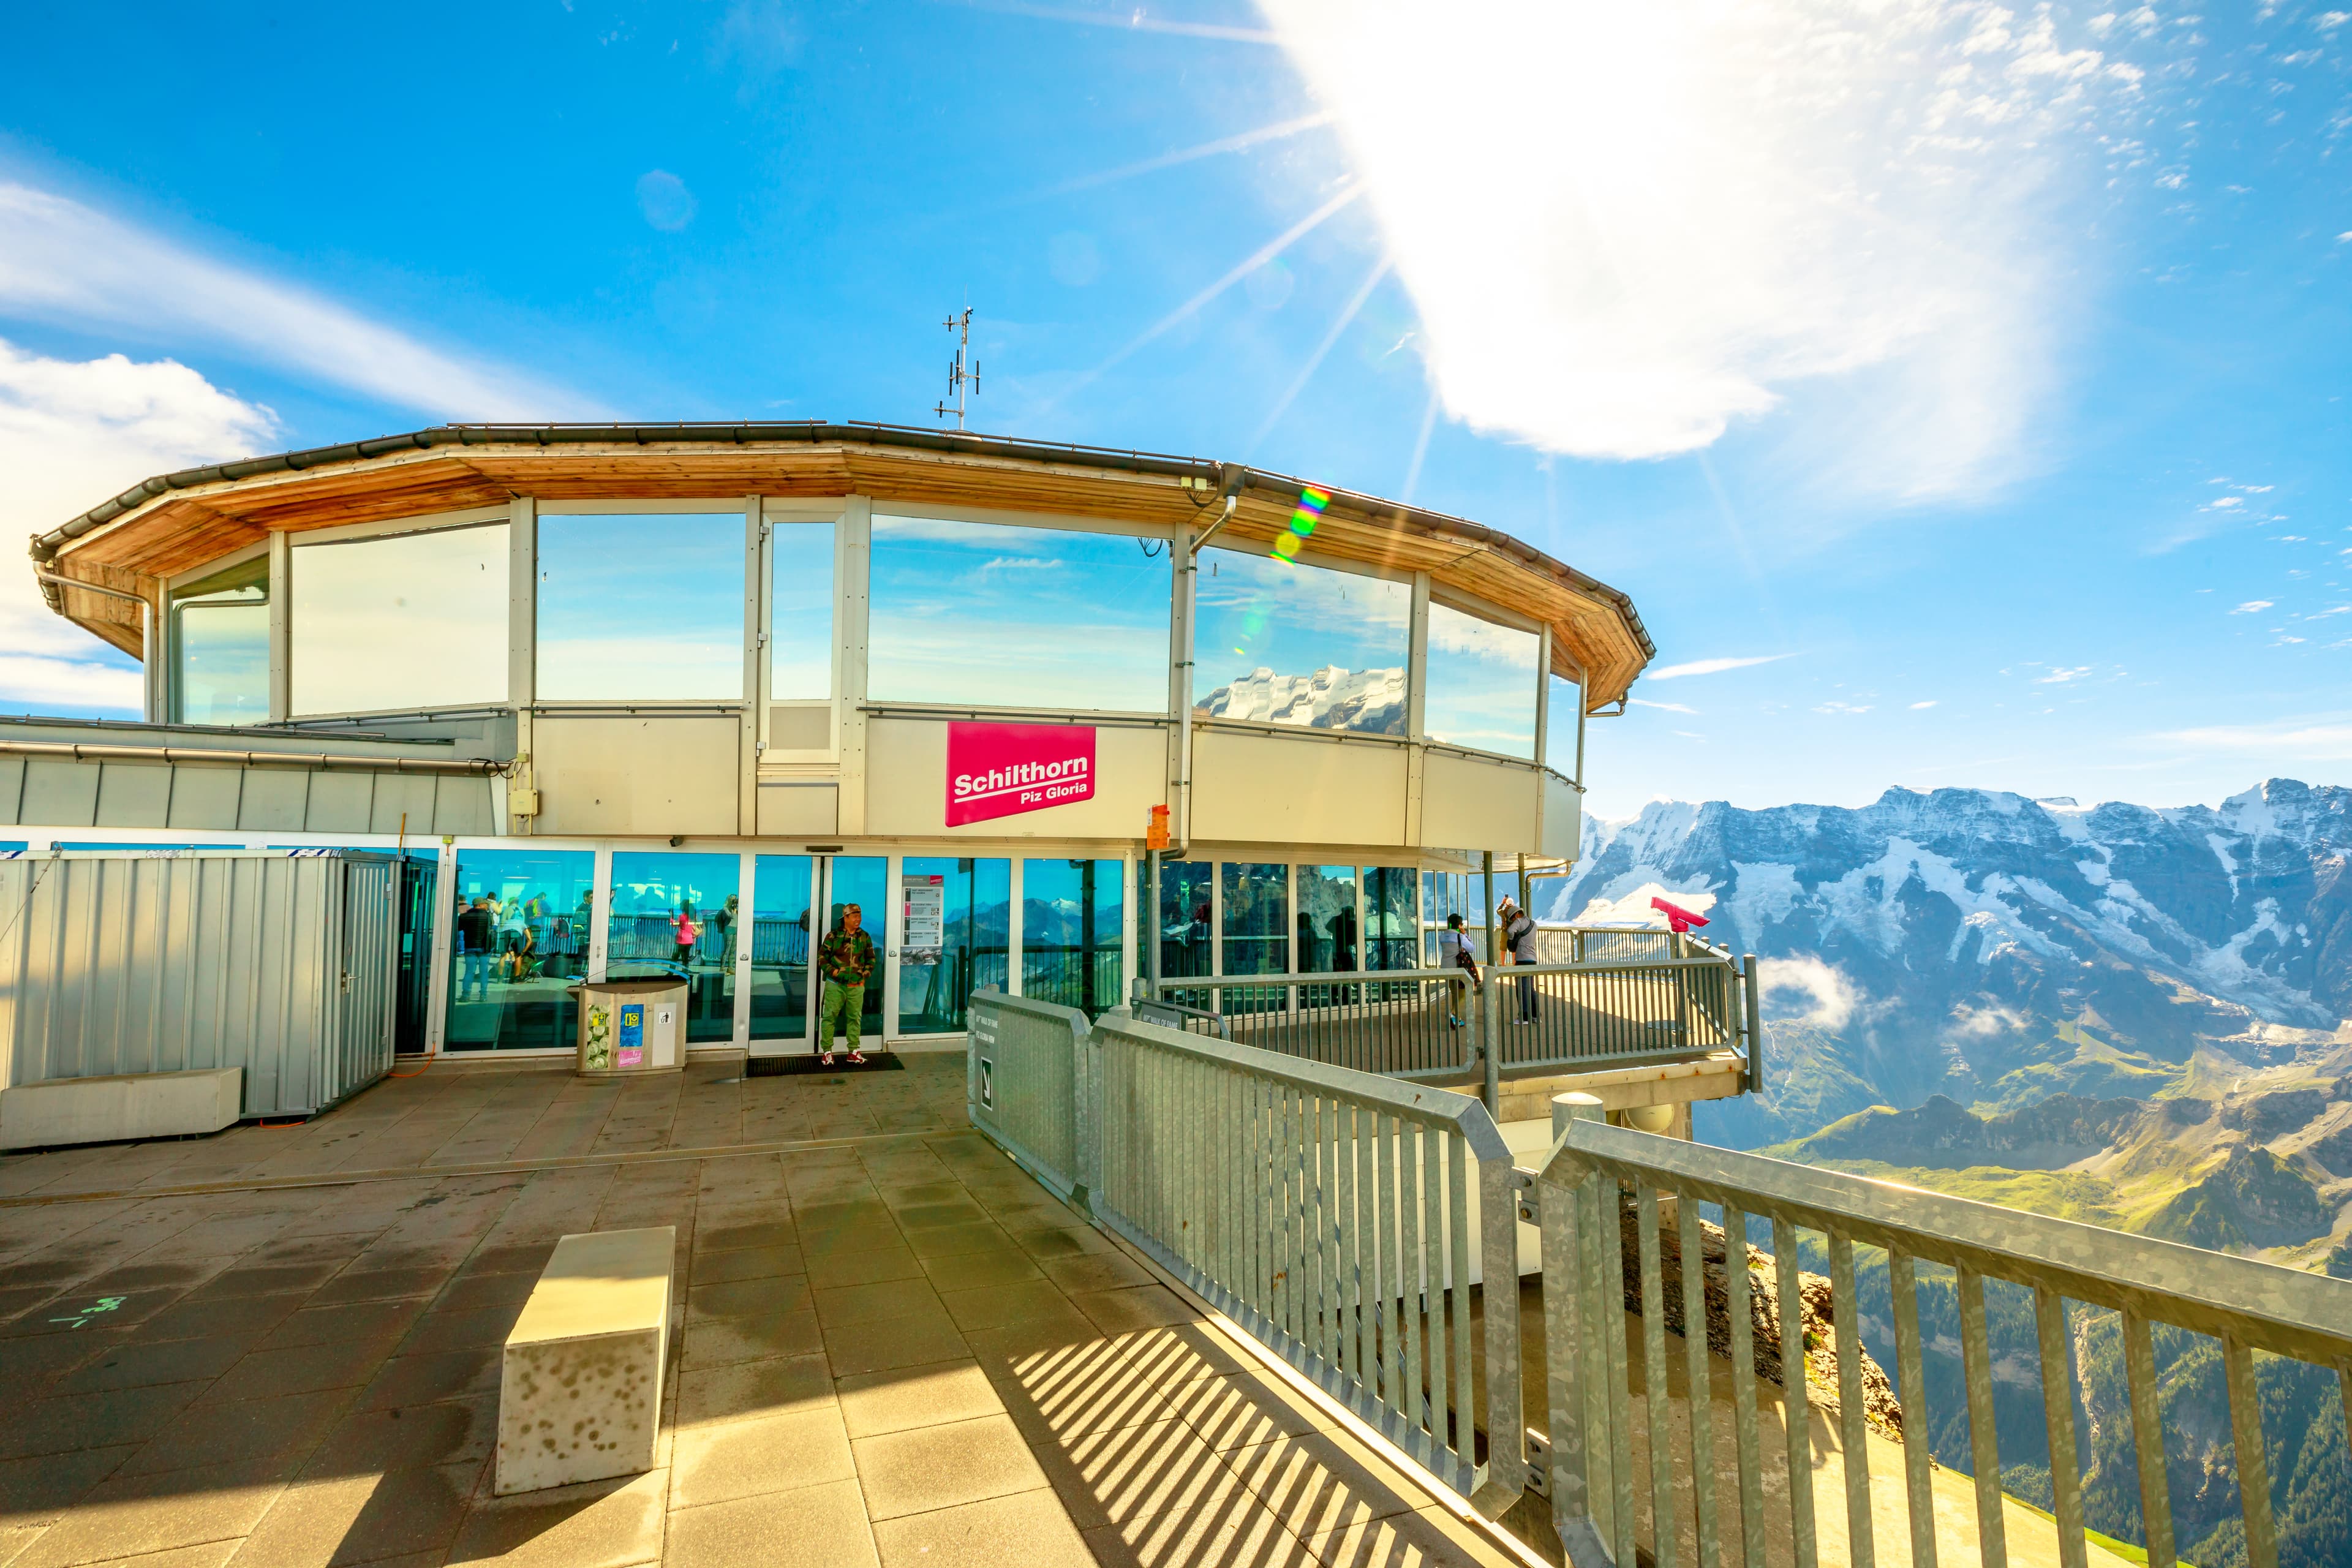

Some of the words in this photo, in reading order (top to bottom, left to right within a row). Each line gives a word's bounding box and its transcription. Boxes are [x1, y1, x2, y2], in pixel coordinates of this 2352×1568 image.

[954, 756, 1087, 796] Schilthorn
[1020, 792, 1042, 804] Piz
[1046, 783, 1087, 799] Gloria
[1161, 1019, 1166, 1027] OF
[1167, 1020, 1178, 1030] FAME
